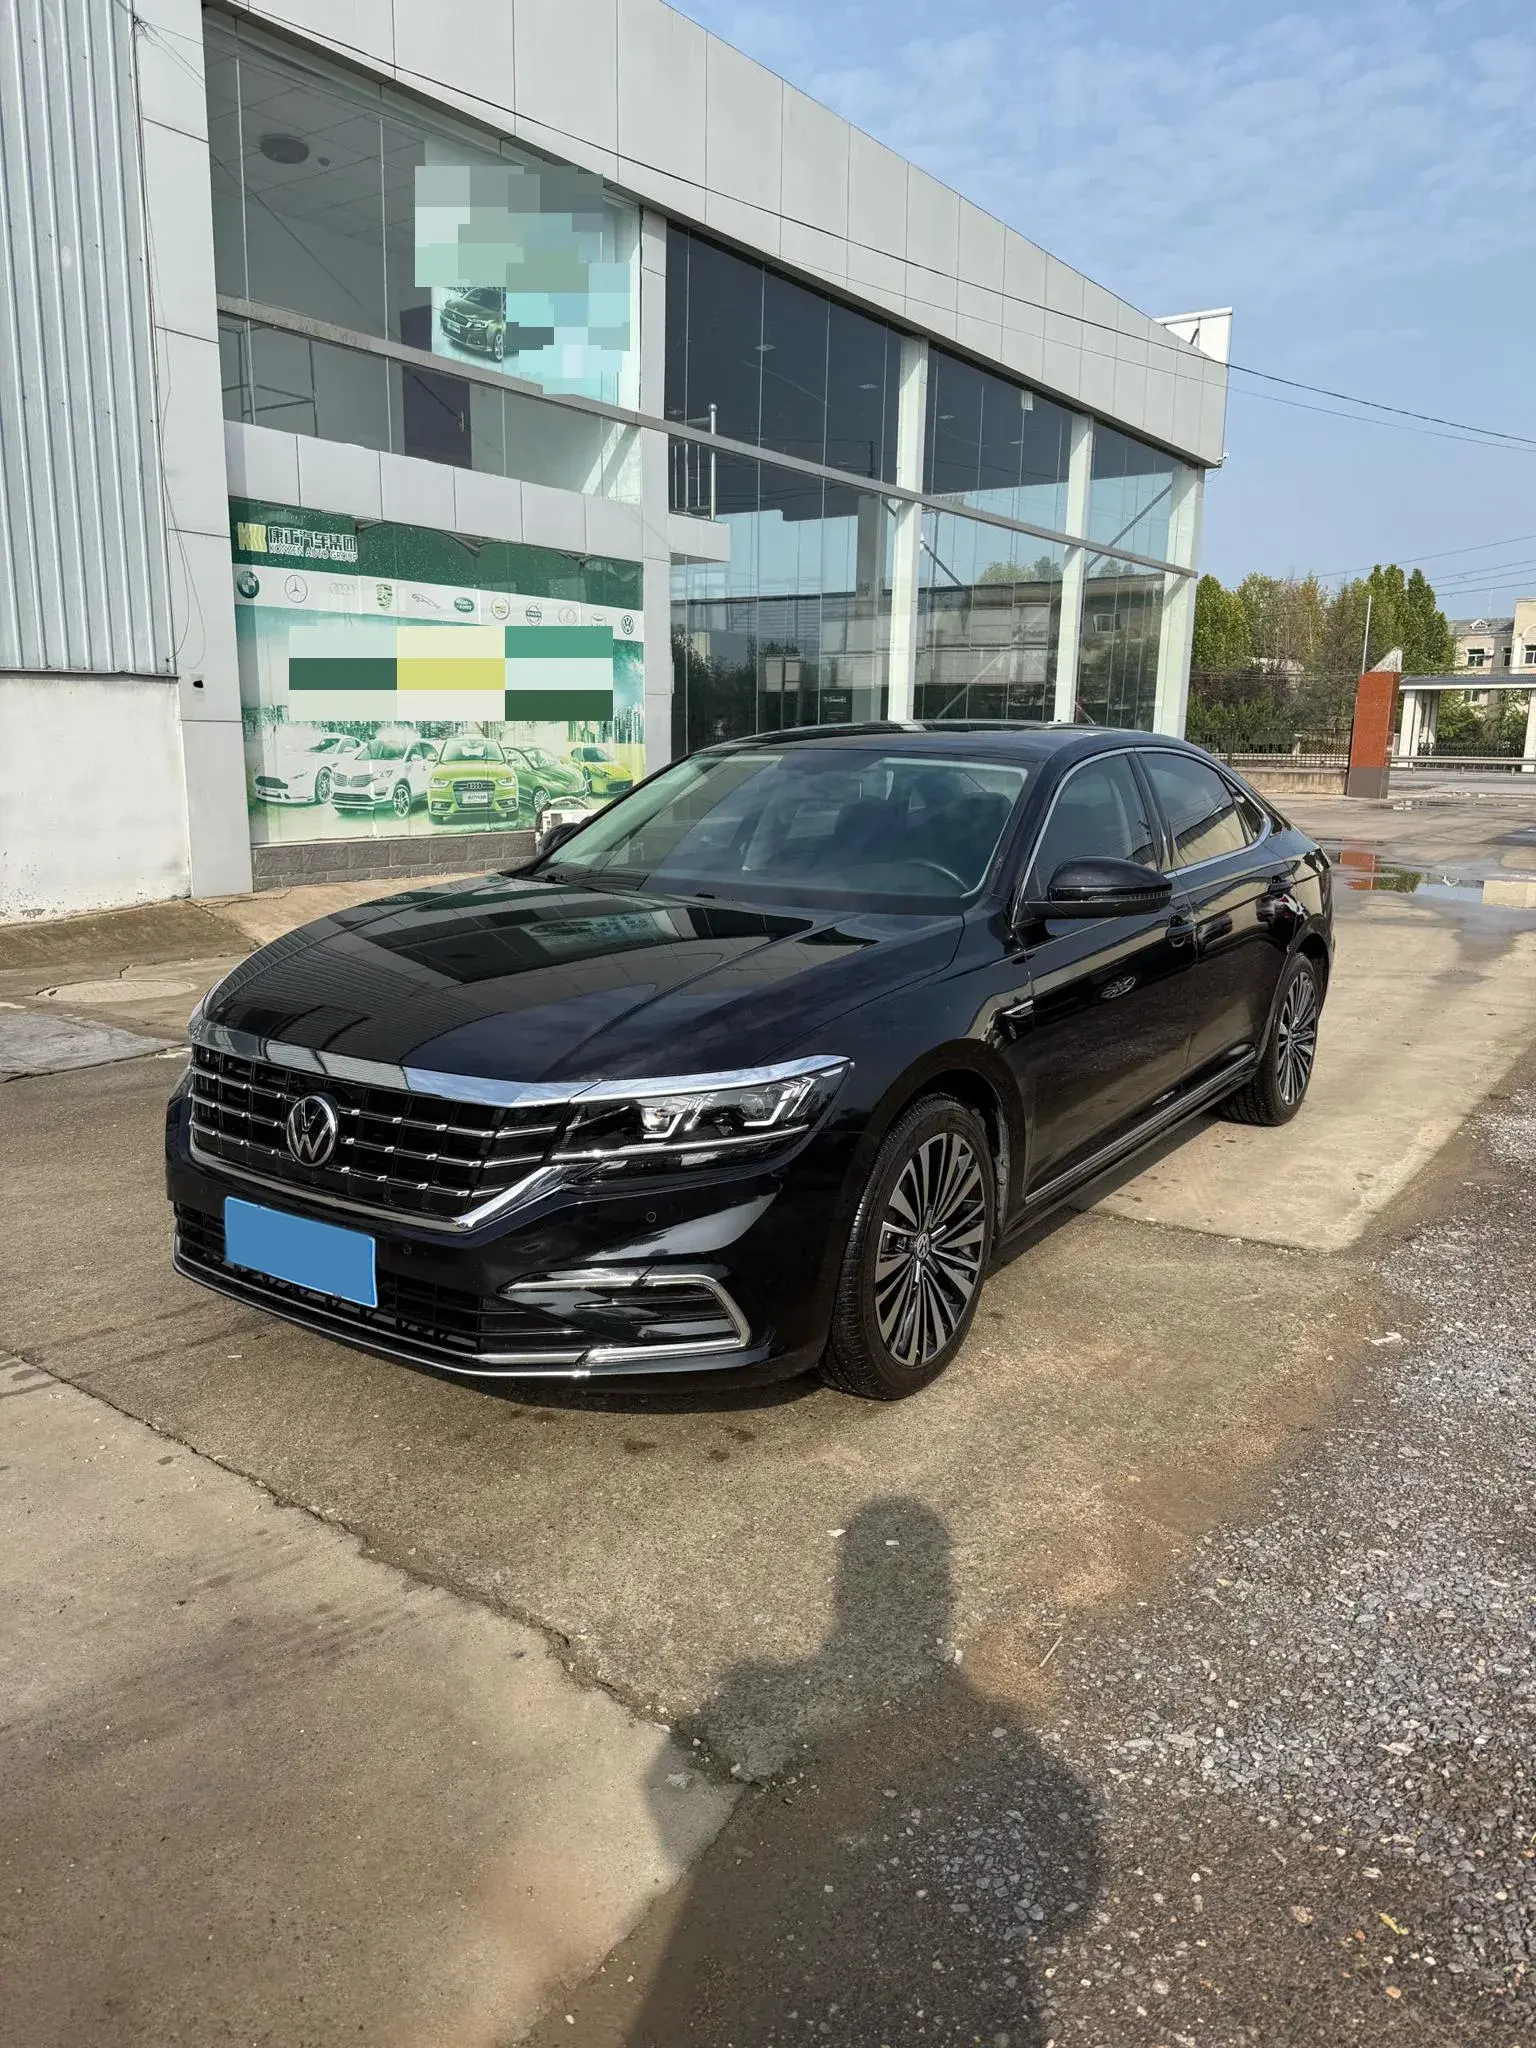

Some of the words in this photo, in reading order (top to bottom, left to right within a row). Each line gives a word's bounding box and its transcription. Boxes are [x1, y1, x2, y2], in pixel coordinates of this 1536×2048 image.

[267, 526, 358, 553] 康正汽车集团
[268, 543, 304, 557] KONZEN
[305, 547, 329, 560] AUTO
[330, 551, 358, 563] GROUP
